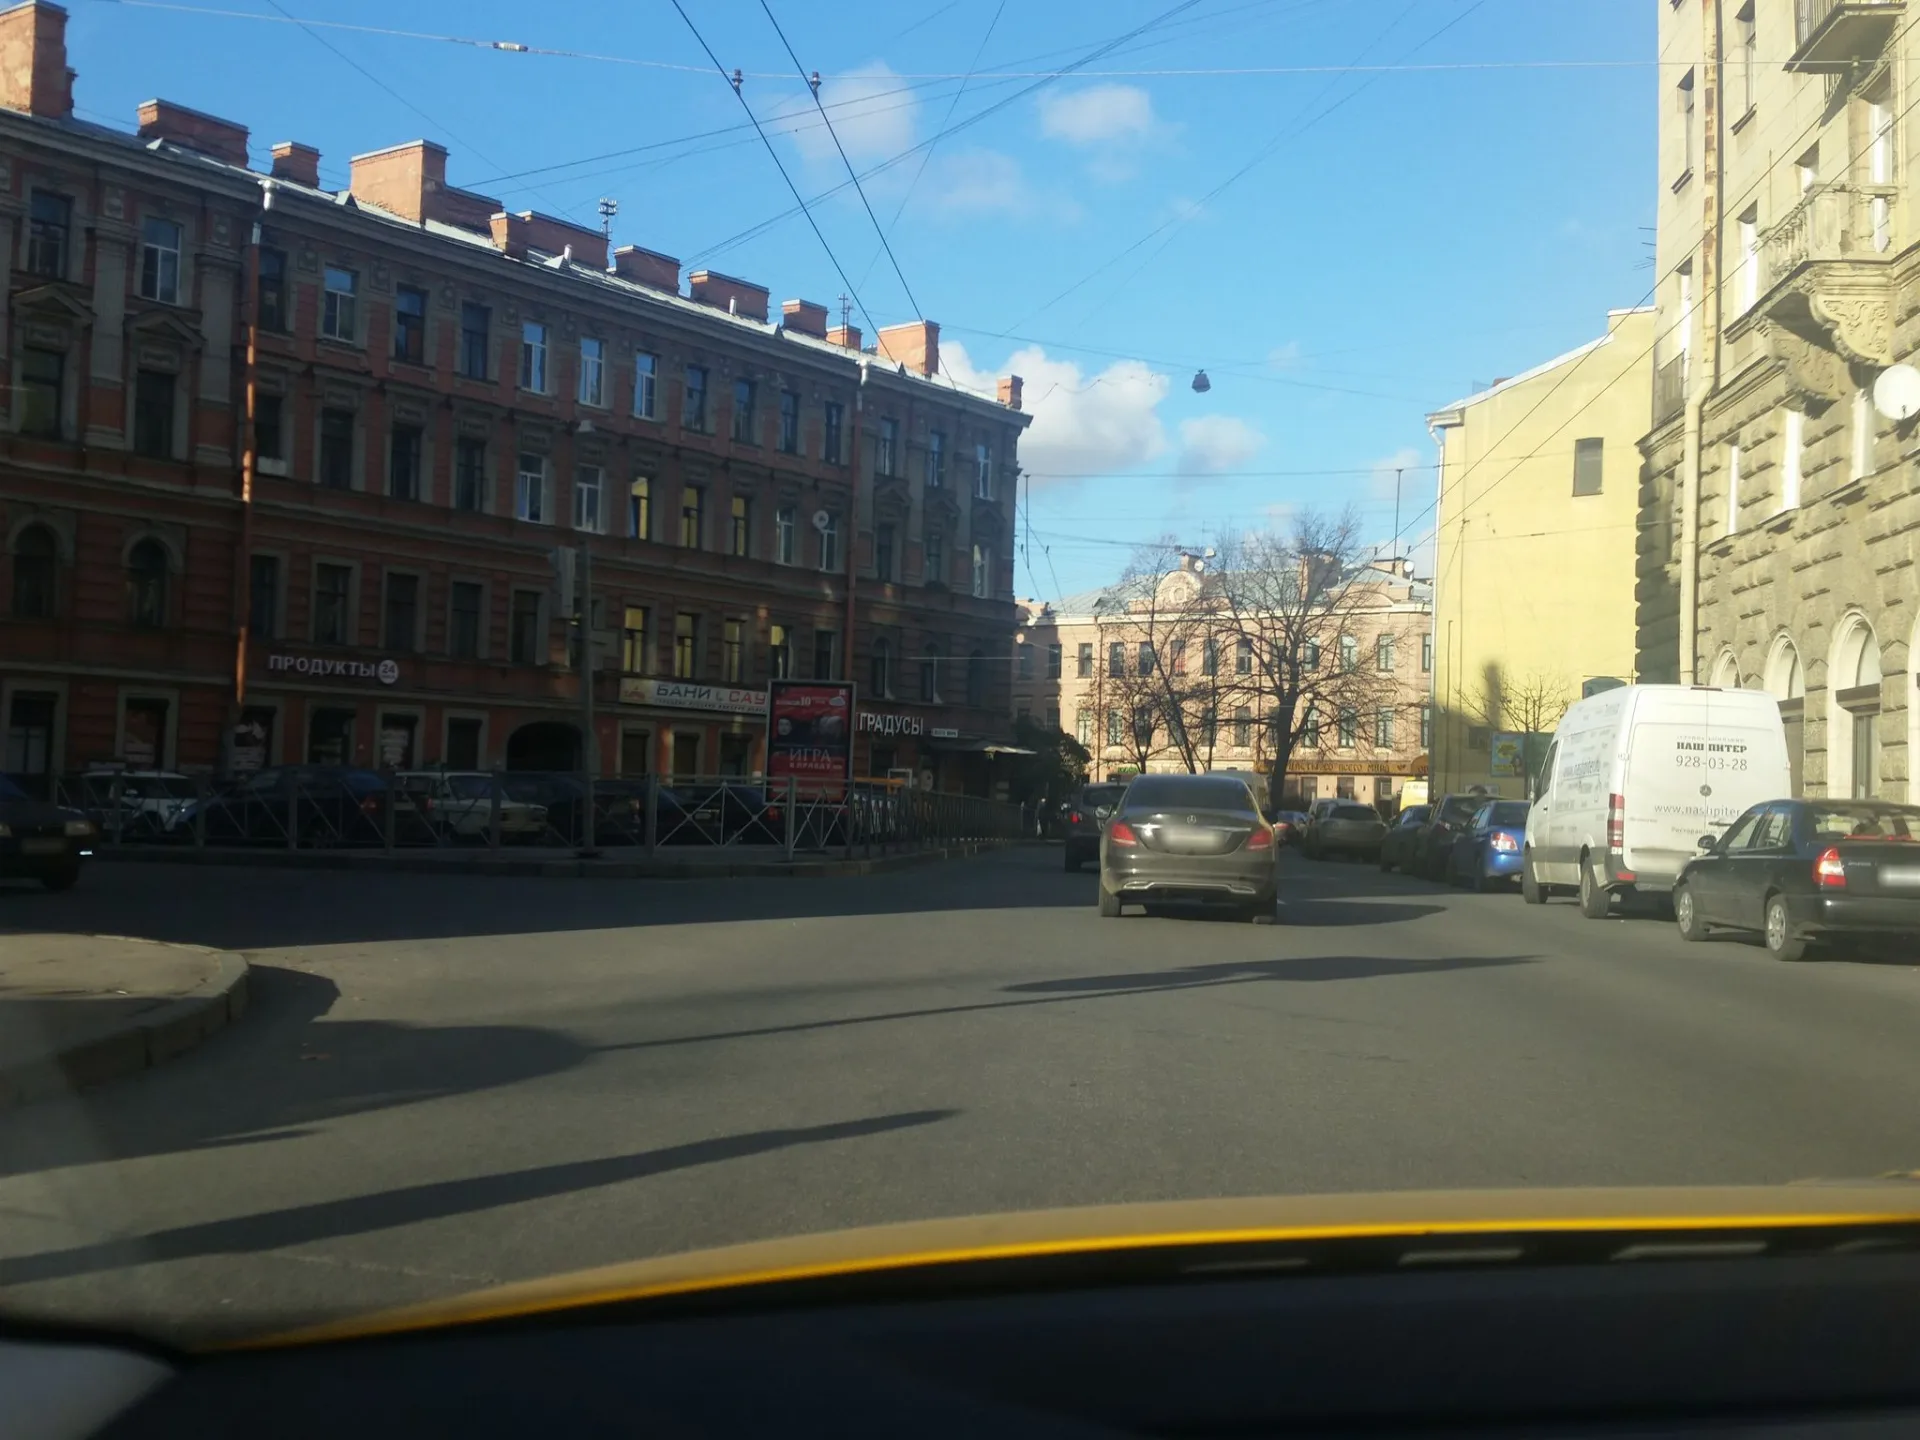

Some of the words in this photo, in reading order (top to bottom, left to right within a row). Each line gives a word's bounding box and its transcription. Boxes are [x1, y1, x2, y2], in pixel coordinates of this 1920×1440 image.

[269, 655, 375, 677] ПРОДУКТЫ
[382, 663, 395, 674] 24
[656, 684, 711, 699] БАНИ
[800, 696, 811, 707] 10
[859, 712, 924, 736] ГРАДУСЫ
[1676, 742, 1704, 751] НАШ
[1708, 743, 1747, 753] ПИТЕР
[790, 748, 831, 762] ИГРА
[1676, 755, 1748, 771] 928-03-28
